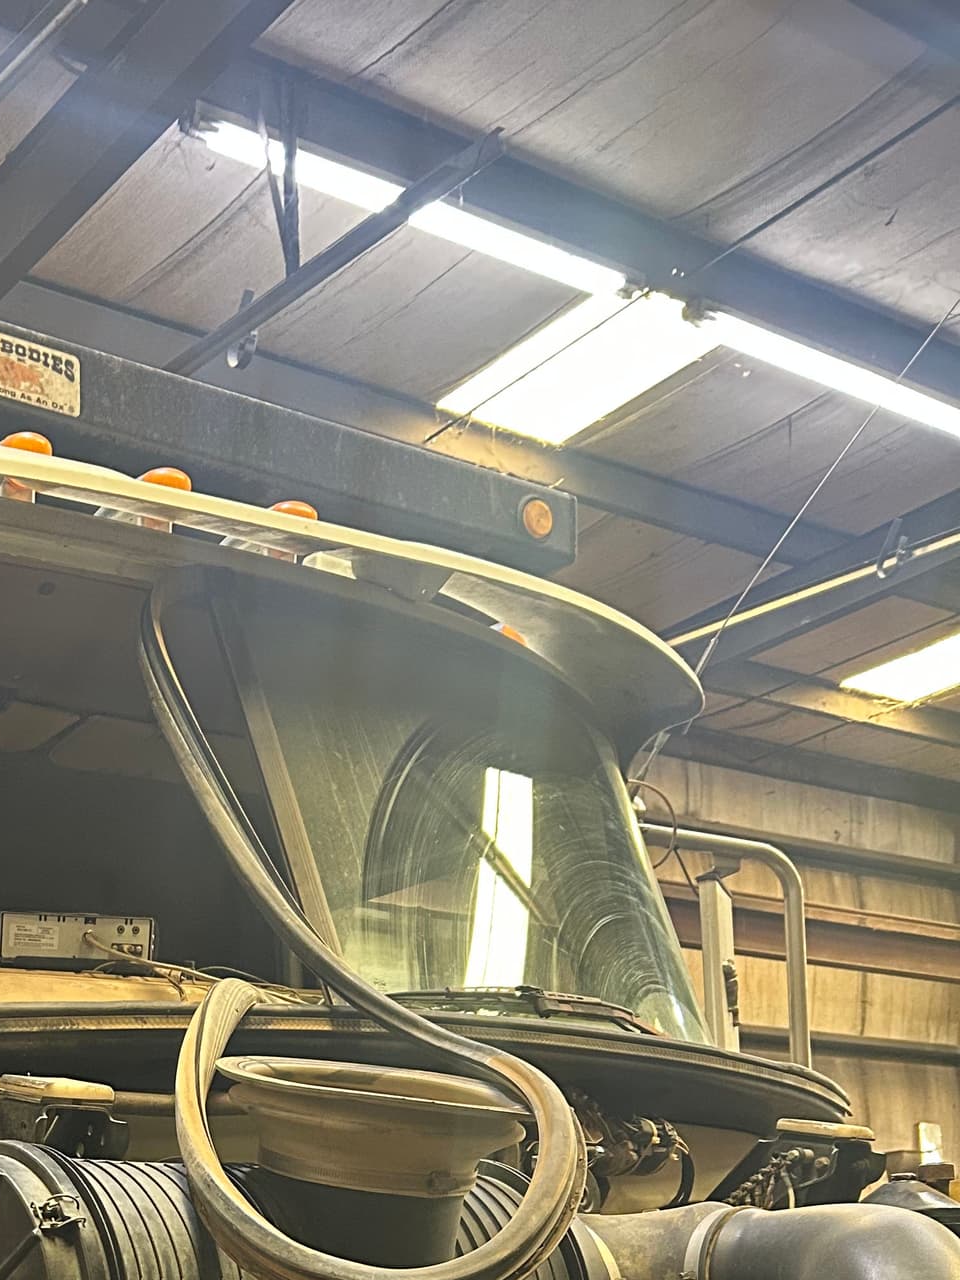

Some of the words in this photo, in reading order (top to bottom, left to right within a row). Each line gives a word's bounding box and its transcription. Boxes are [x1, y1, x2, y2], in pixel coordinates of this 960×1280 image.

[0, 338, 76, 384] BODIES
[20, 392, 33, 402] As
[36, 396, 49, 407] An
